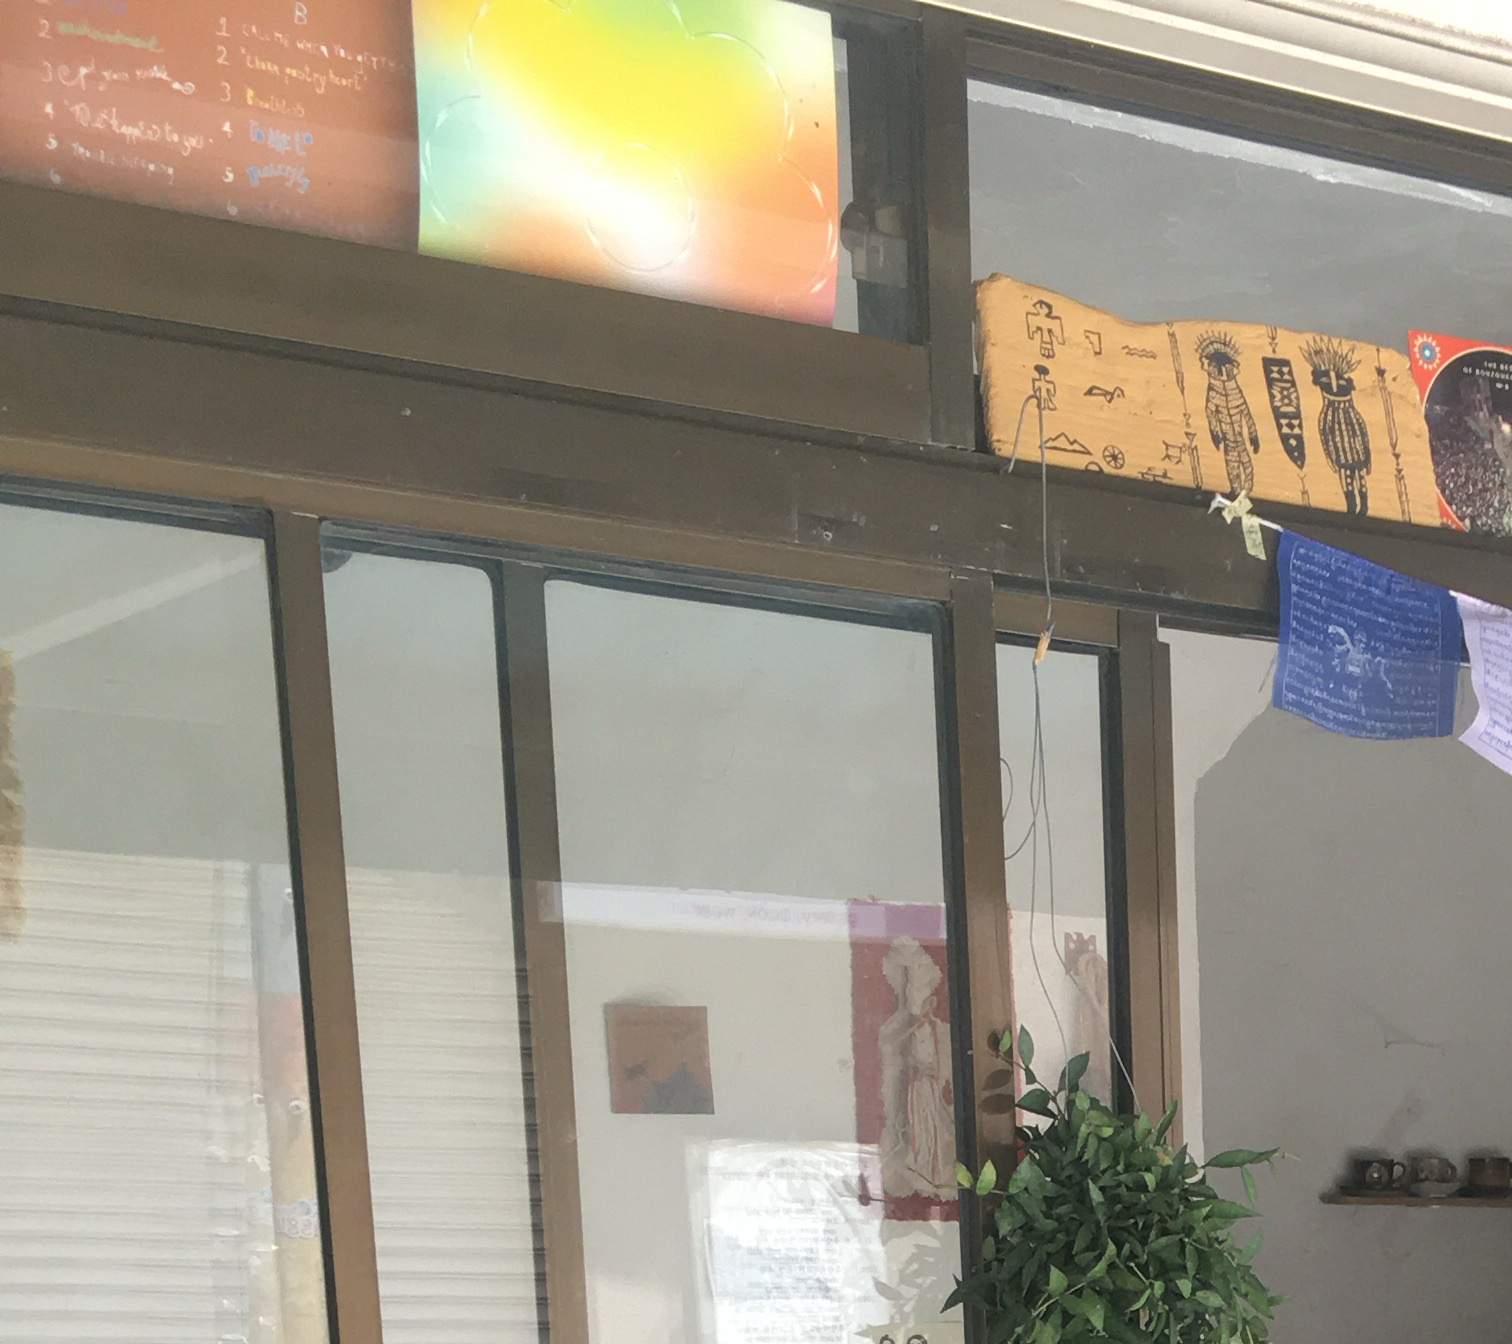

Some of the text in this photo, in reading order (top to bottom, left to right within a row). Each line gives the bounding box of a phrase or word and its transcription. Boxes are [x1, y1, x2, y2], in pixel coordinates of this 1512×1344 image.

[294, 1, 307, 24] B
[37, 18, 53, 39] 2
[215, 16, 231, 37] 1
[215, 45, 230, 66] 2
[219, 81, 231, 103] 3
[222, 166, 235, 184] 5
[1462, 366, 1473, 375] OF
[1483, 360, 1497, 370] THE
